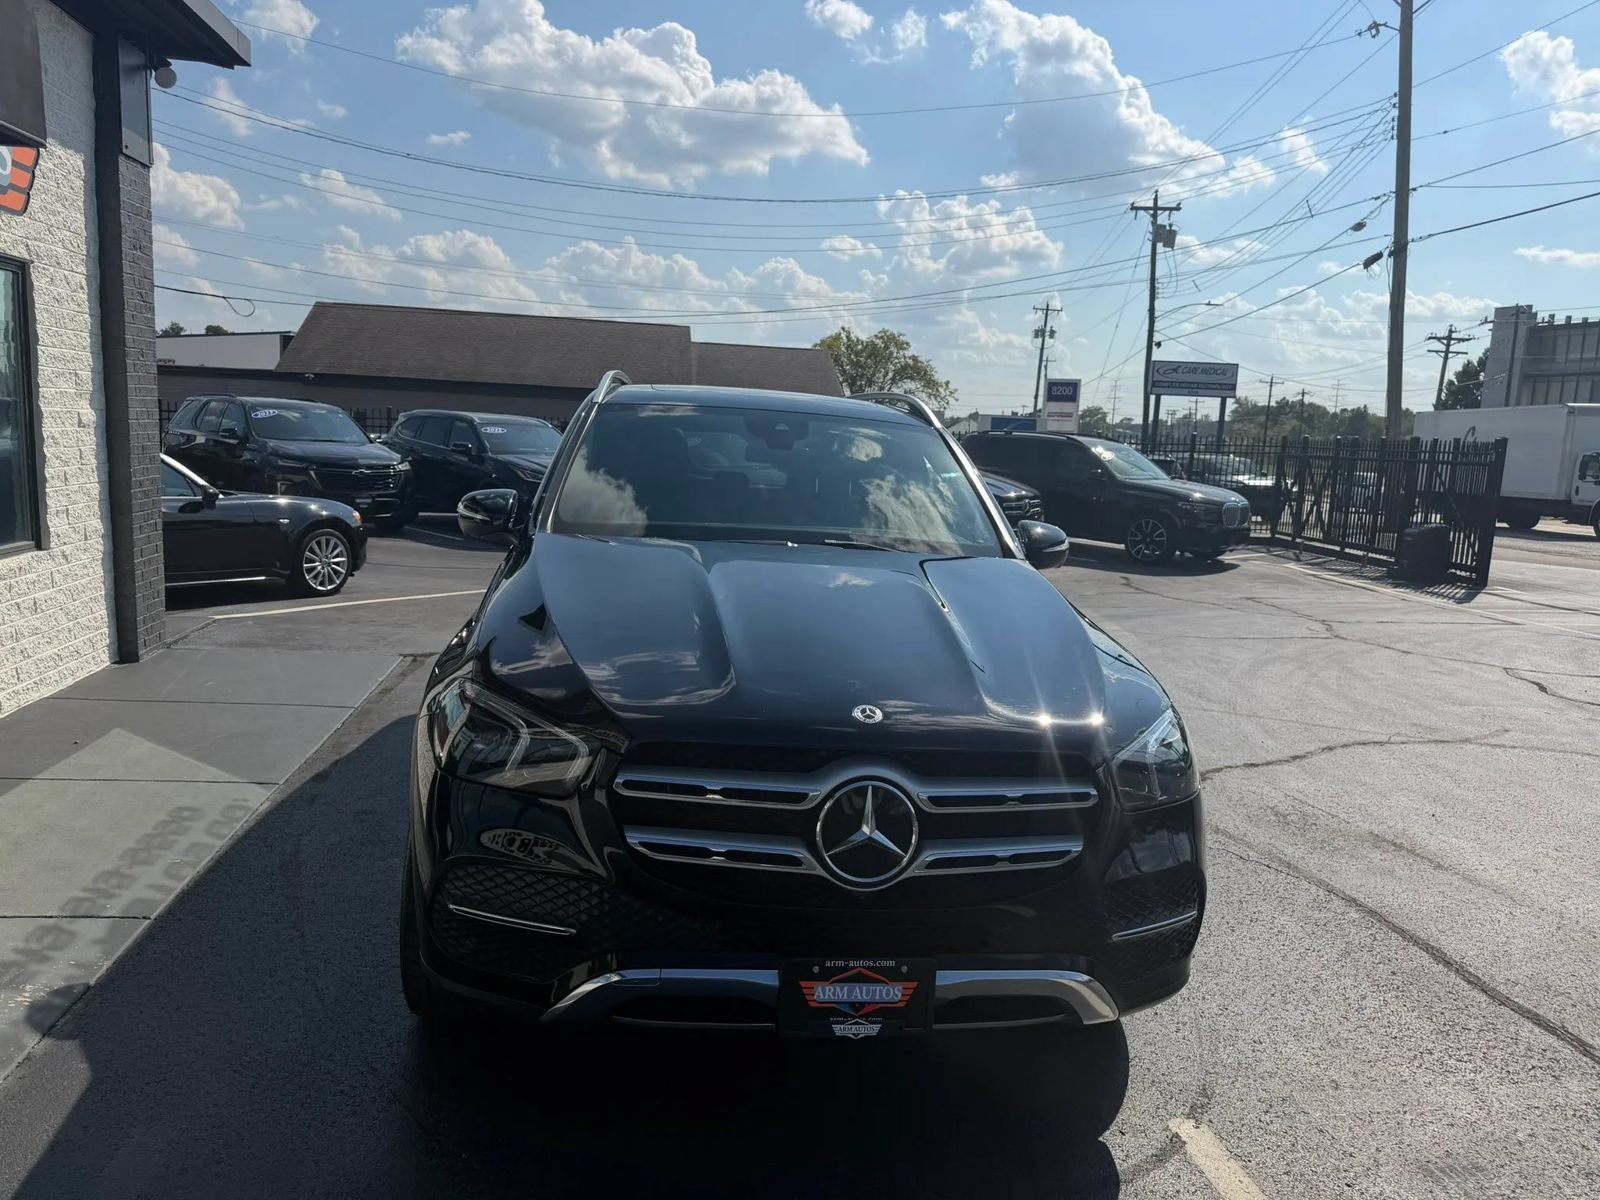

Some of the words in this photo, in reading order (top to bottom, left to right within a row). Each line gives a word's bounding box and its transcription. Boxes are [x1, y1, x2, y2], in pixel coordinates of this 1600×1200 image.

[1052, 385, 1073, 396] 8200
[825, 959, 896, 967] arm-autos.com
[814, 986, 848, 1000] ARM
[851, 986, 902, 1000] AUTOS
